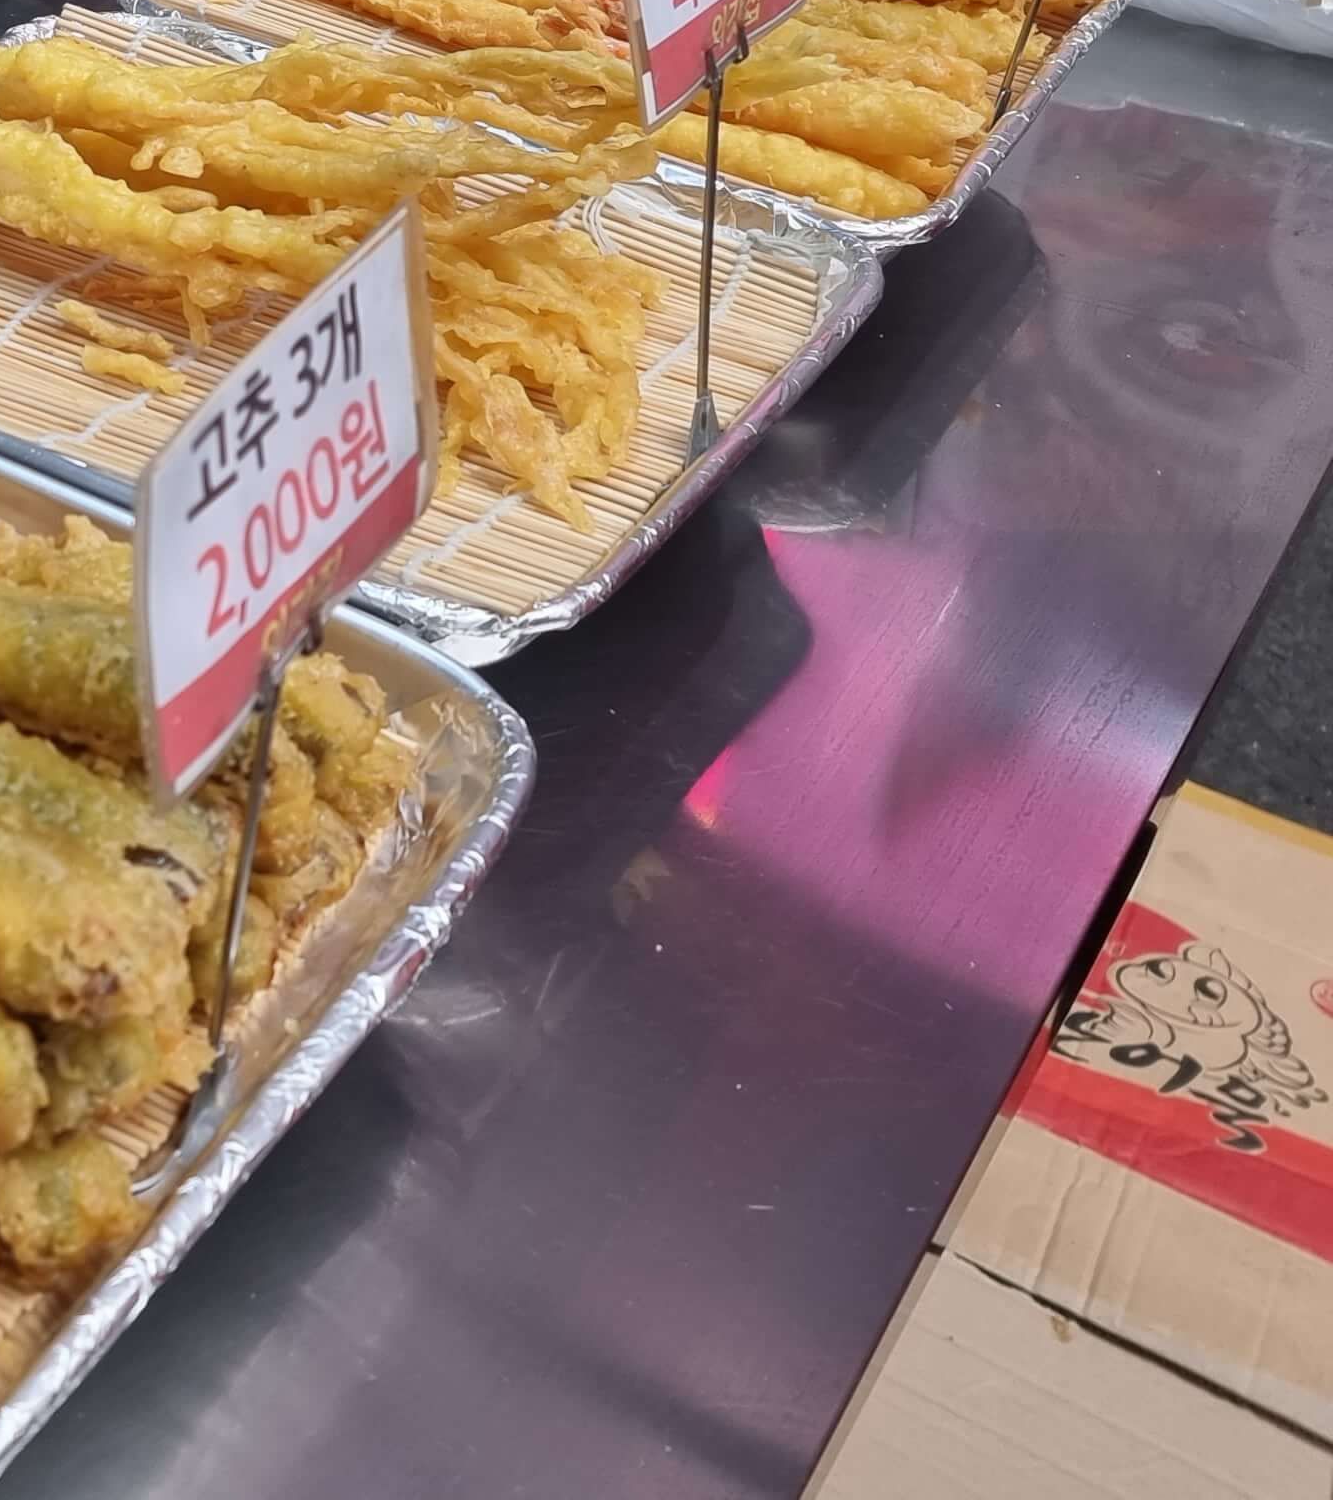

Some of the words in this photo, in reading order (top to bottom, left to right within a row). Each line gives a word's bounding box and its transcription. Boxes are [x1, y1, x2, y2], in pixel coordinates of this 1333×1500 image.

[187, 368, 279, 522] 고추
[288, 282, 364, 420] 3개
[195, 380, 391, 639] 2,000원
